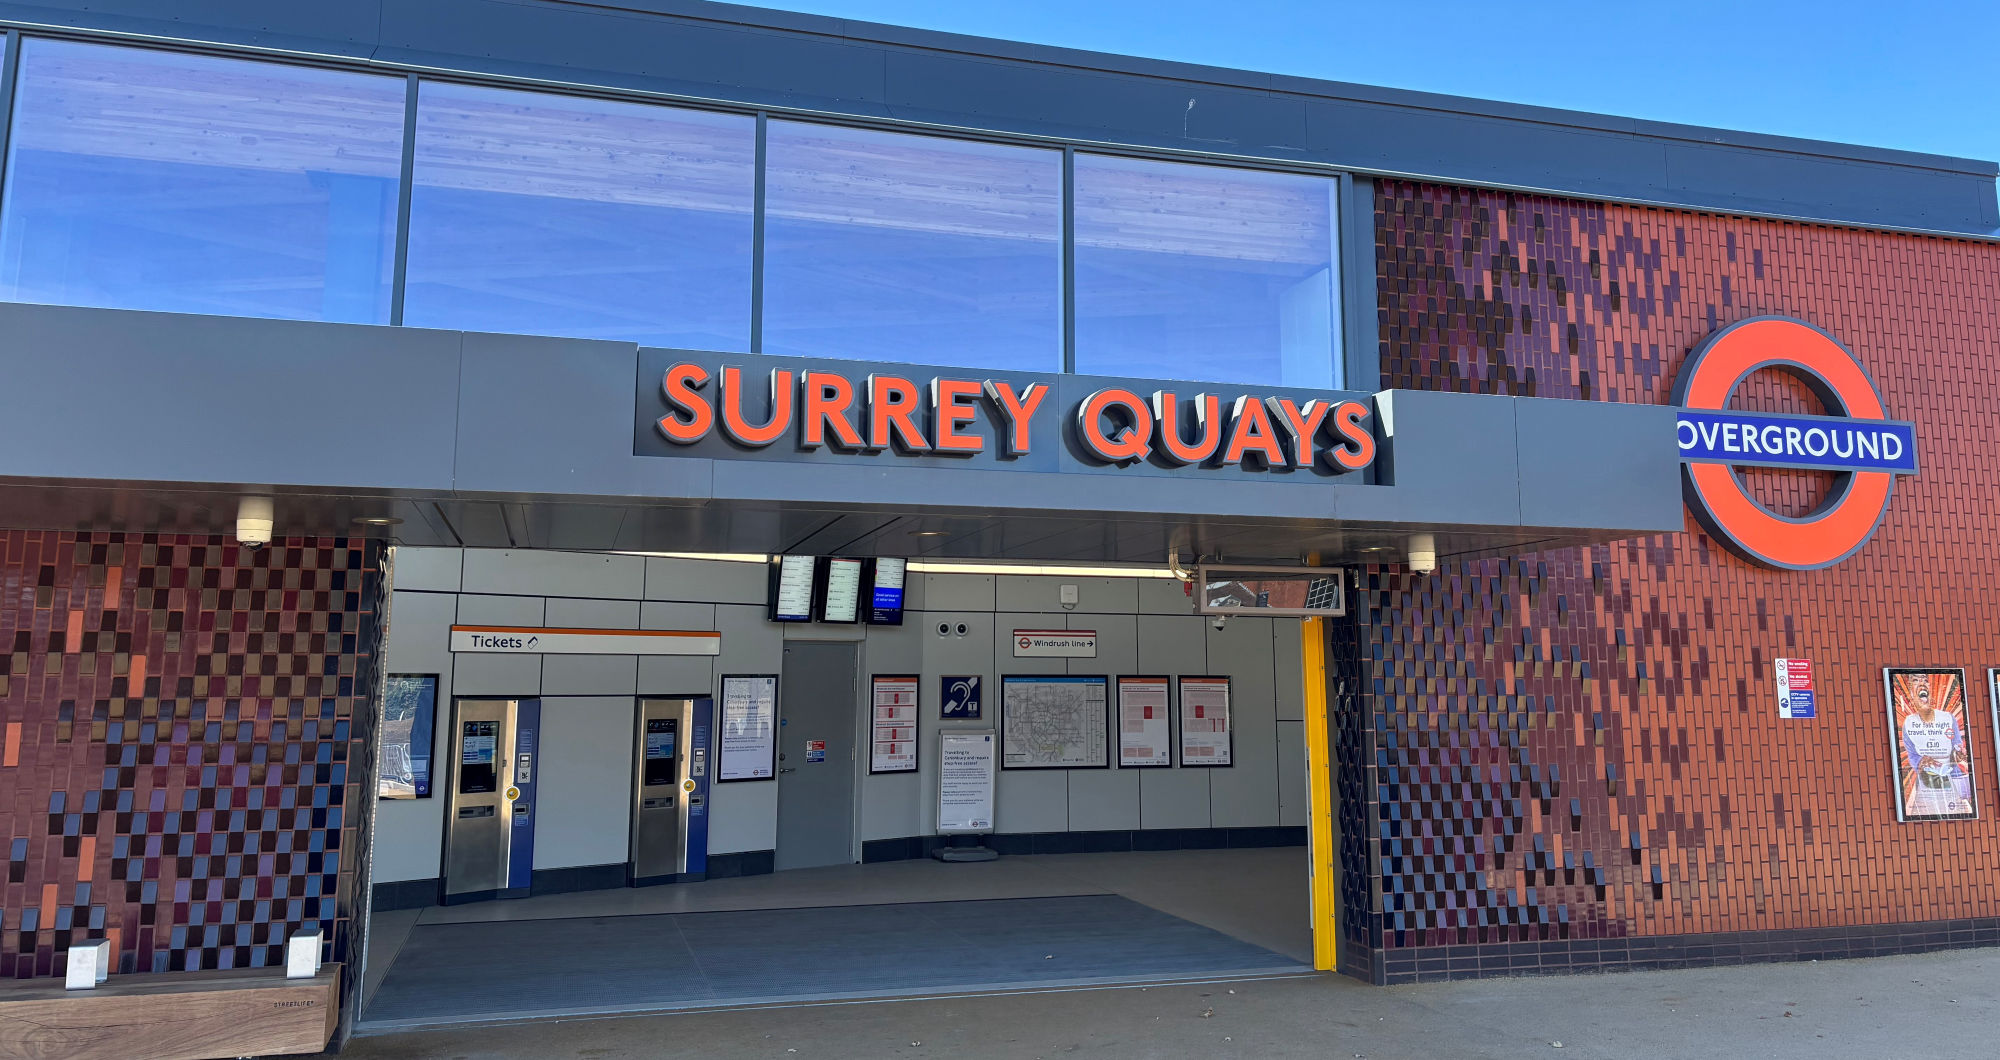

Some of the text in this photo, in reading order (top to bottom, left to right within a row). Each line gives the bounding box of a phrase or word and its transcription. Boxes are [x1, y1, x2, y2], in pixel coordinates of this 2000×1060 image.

[657, 361, 1377, 469] SURREY QUAYS
[1677, 419, 1903, 461] OVERGROUND
[471, 635, 523, 648] Tickets
[1033, 639, 1086, 647] Windrush line
